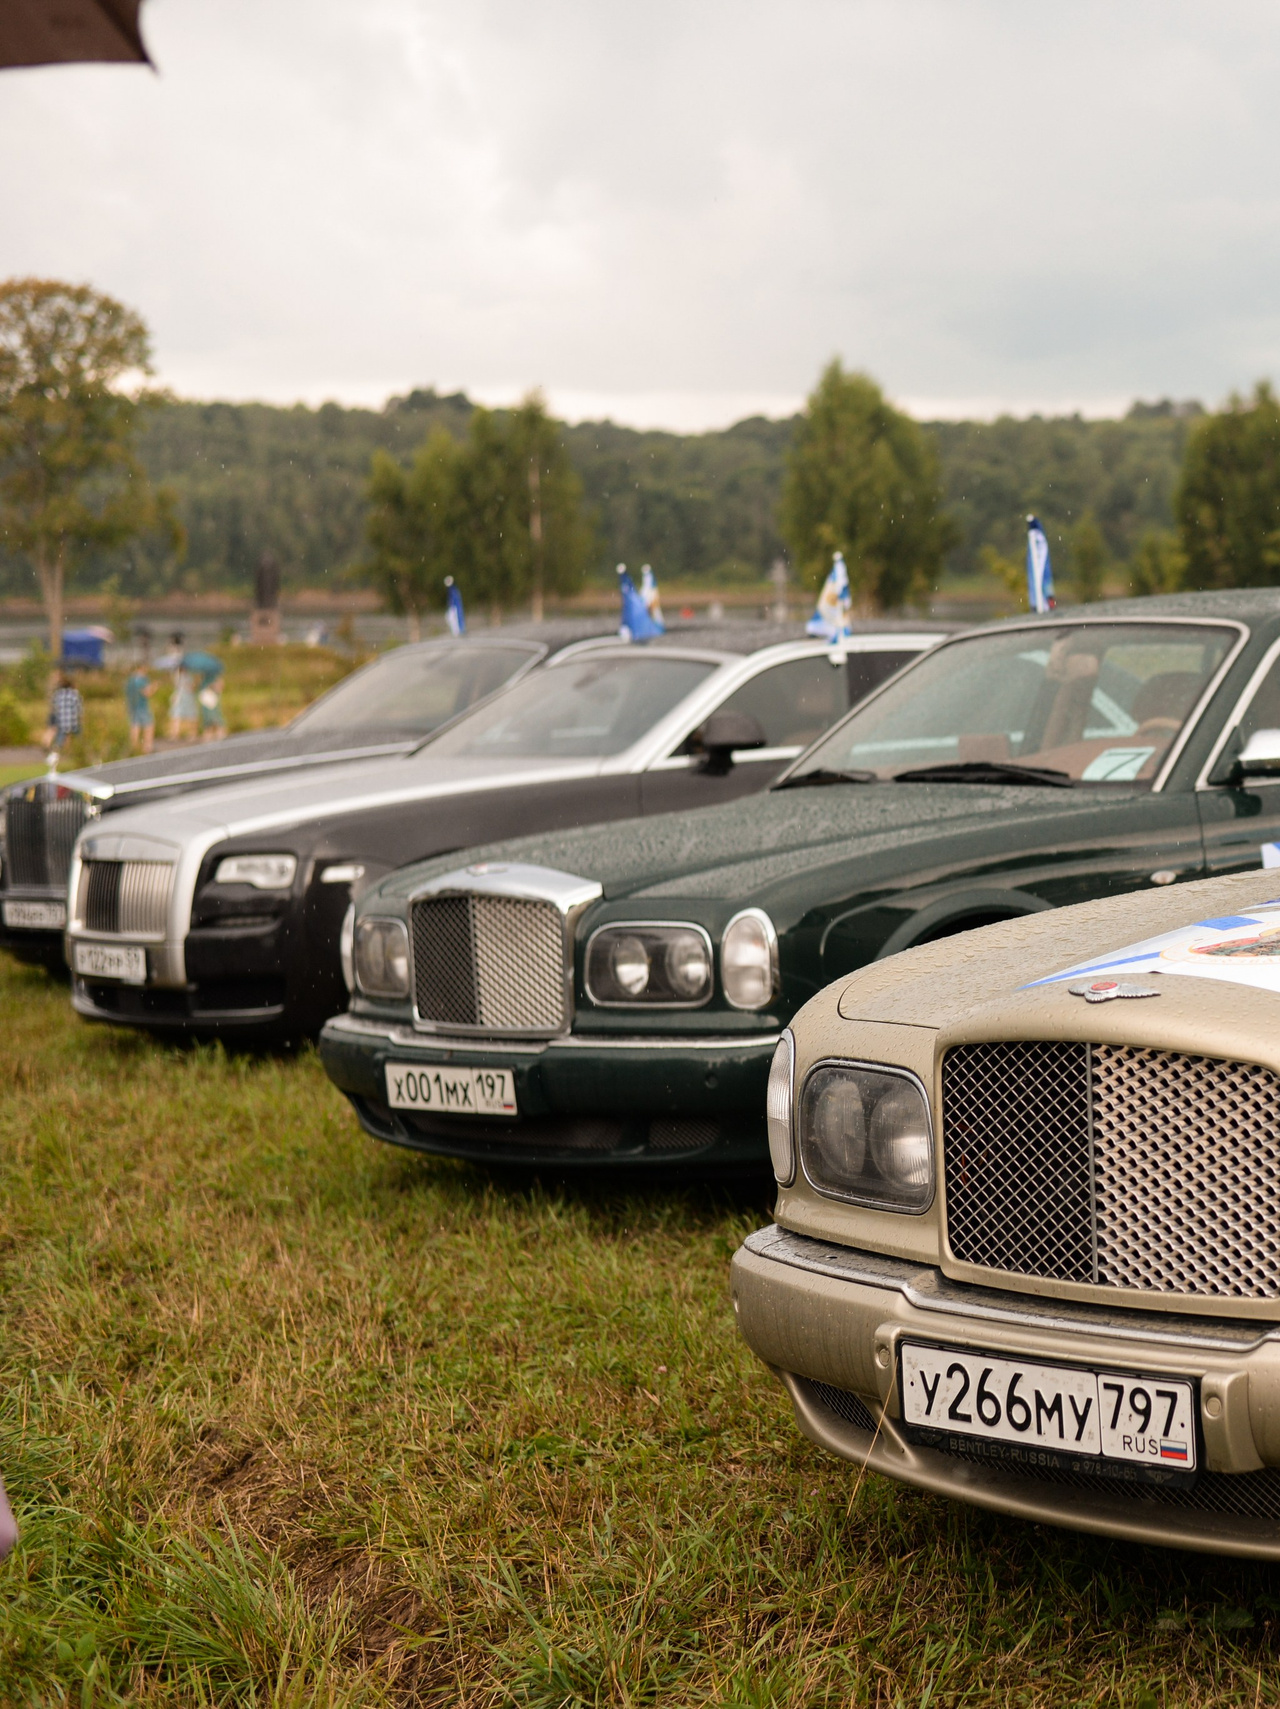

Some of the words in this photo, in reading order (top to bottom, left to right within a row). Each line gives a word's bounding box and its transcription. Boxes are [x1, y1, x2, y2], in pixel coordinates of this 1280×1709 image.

[476, 1073, 506, 1099] 197
[919, 1362, 1093, 1442] У266МУ
[1103, 1382, 1178, 1438] 797
[950, 1438, 1060, 1469] BENTLEY-RUSSIA
[1123, 1435, 1159, 1456] RUS
